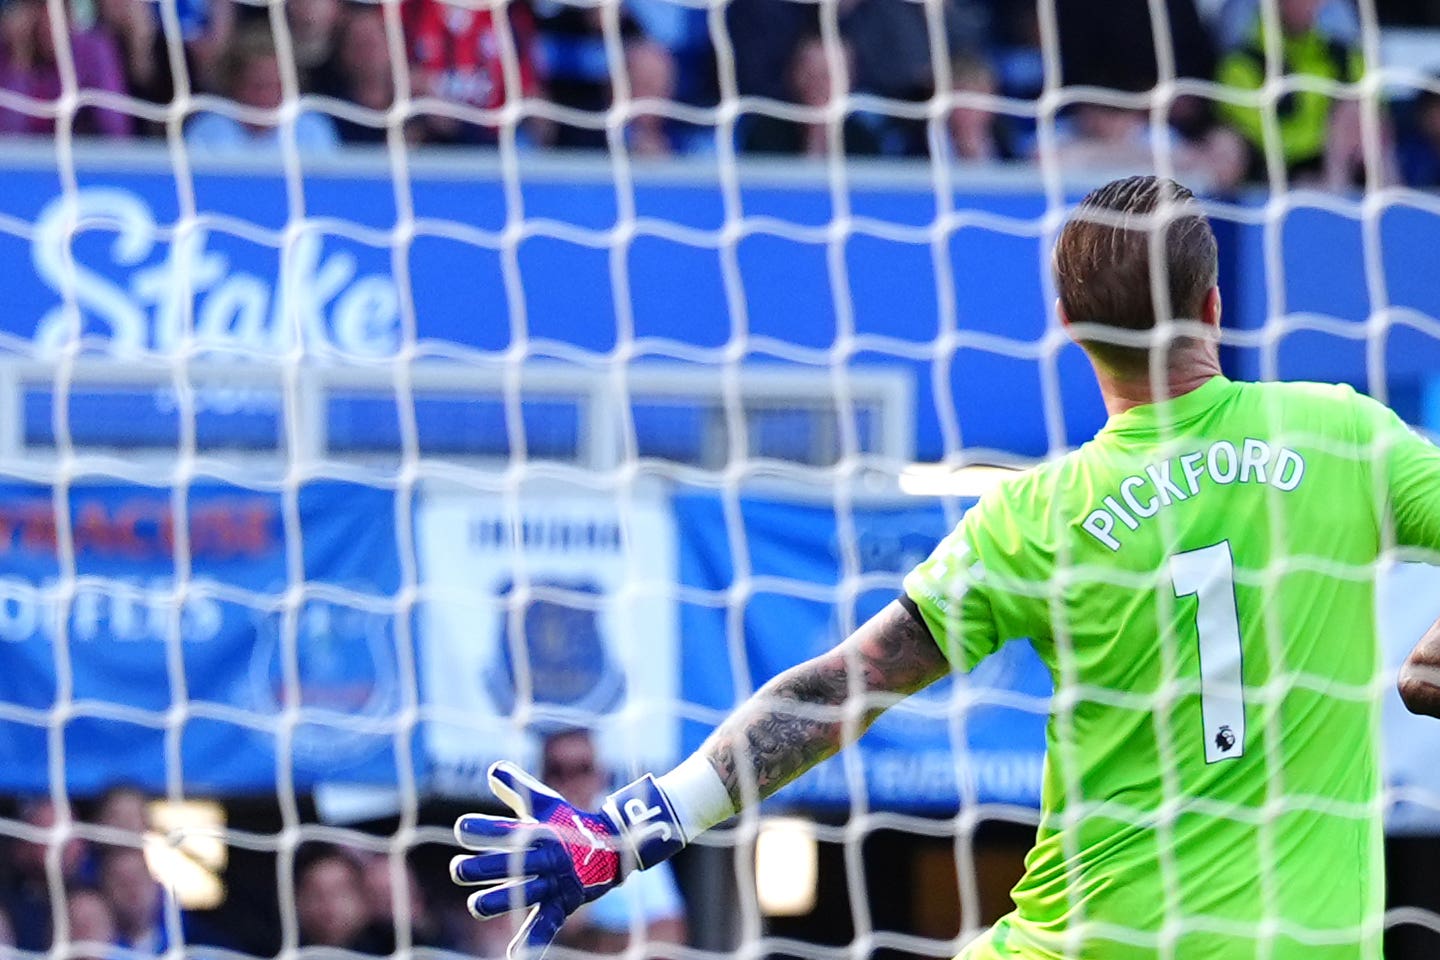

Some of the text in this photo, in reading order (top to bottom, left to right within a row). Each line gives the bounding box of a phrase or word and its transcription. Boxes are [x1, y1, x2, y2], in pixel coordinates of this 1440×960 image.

[31, 185, 402, 358] Stake
[1080, 436, 1306, 552] PICKFORD
[1169, 538, 1246, 764] 1
